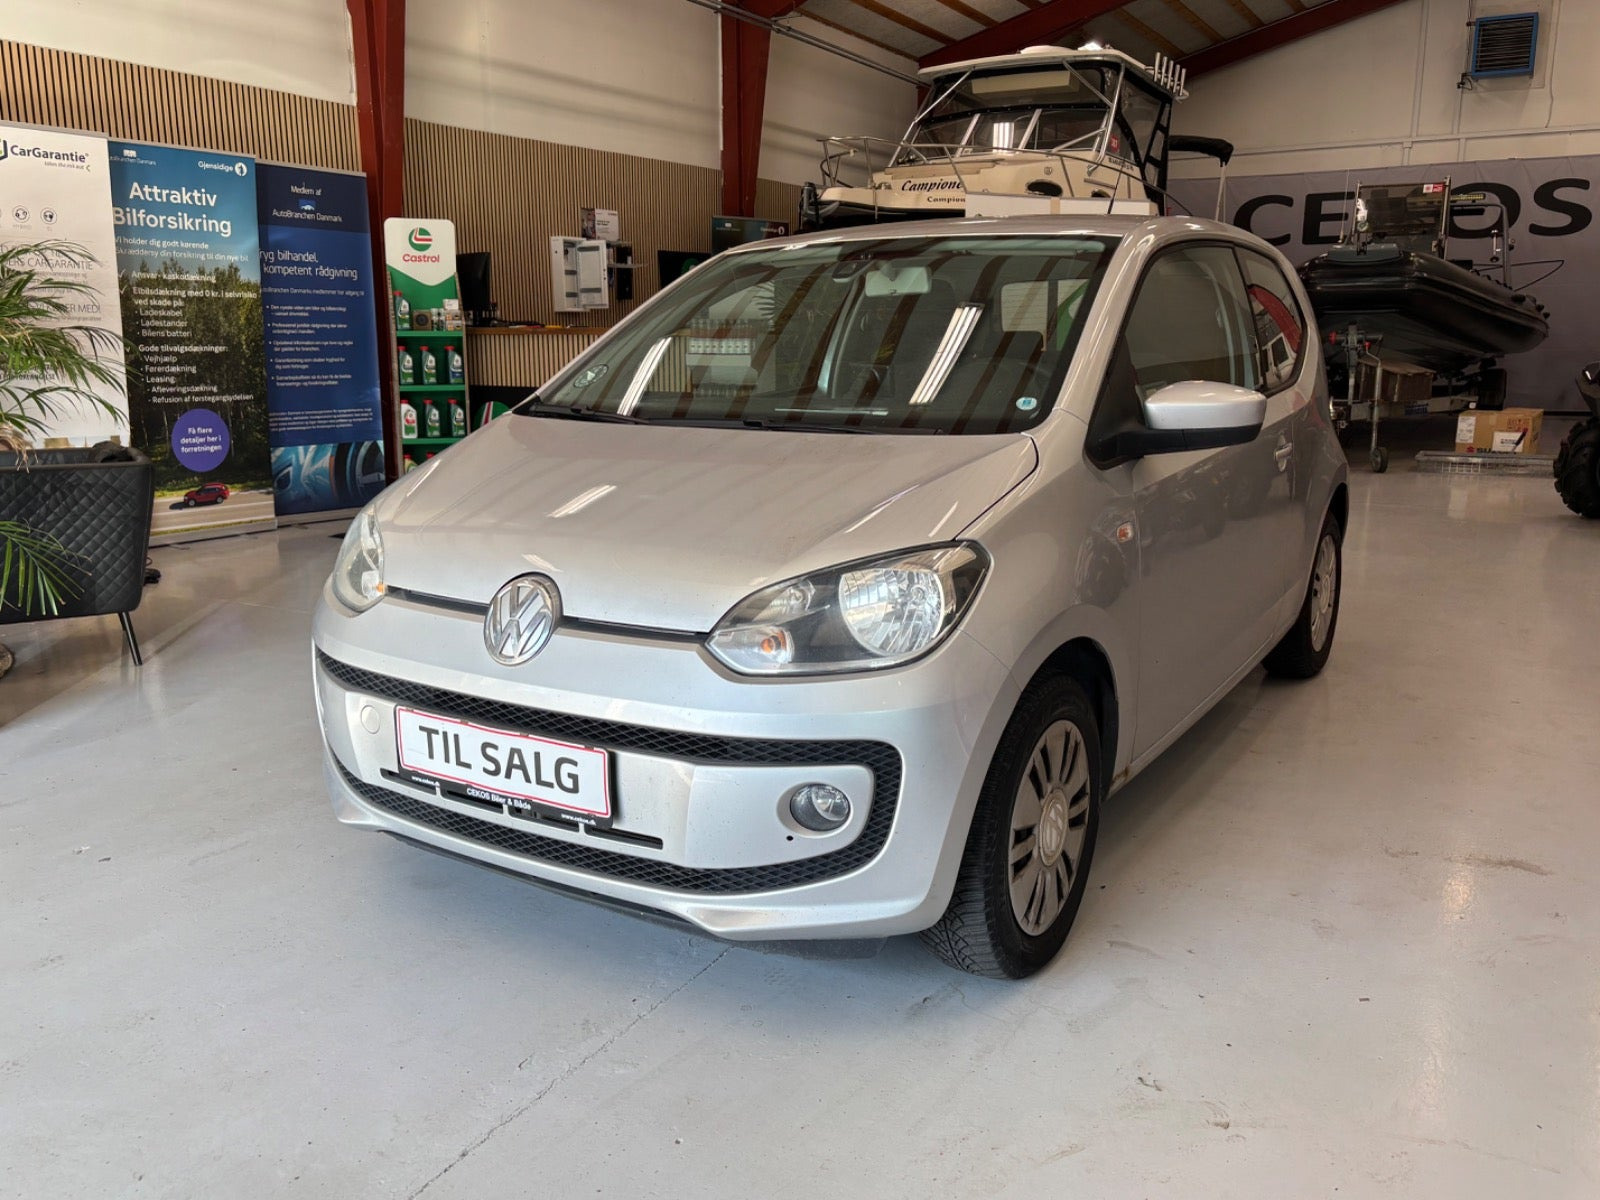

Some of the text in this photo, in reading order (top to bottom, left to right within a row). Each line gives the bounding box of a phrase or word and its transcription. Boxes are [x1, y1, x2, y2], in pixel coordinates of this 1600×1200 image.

[10, 144, 86, 162] CarGarantie
[198, 161, 233, 172] Gjensidige
[129, 182, 217, 207] Attraktiv
[272, 208, 343, 223] AutoBranchen Danmark
[1232, 177, 1593, 247] CEOS
[112, 206, 231, 237] Bilforsikring
[123, 237, 148, 245] holder
[149, 238, 161, 248] dig
[162, 239, 179, 248] godt
[172, 251, 206, 261] forsikring
[259, 248, 274, 263] ryg
[402, 253, 440, 263] Castrol
[263, 263, 358, 281] kompetent rådgivning
[187, 289, 204, 297] med
[134, 298, 148, 306] ved
[149, 298, 172, 307] skade
[139, 308, 183, 317] Ladeskabel
[140, 319, 188, 327] Ladestander
[141, 329, 165, 337] Bilens
[138, 344, 160, 353] Gode
[180, 445, 222, 454] forretningen
[418, 724, 580, 794] TIL SALG
[466, 787, 490, 800] CEKOS
